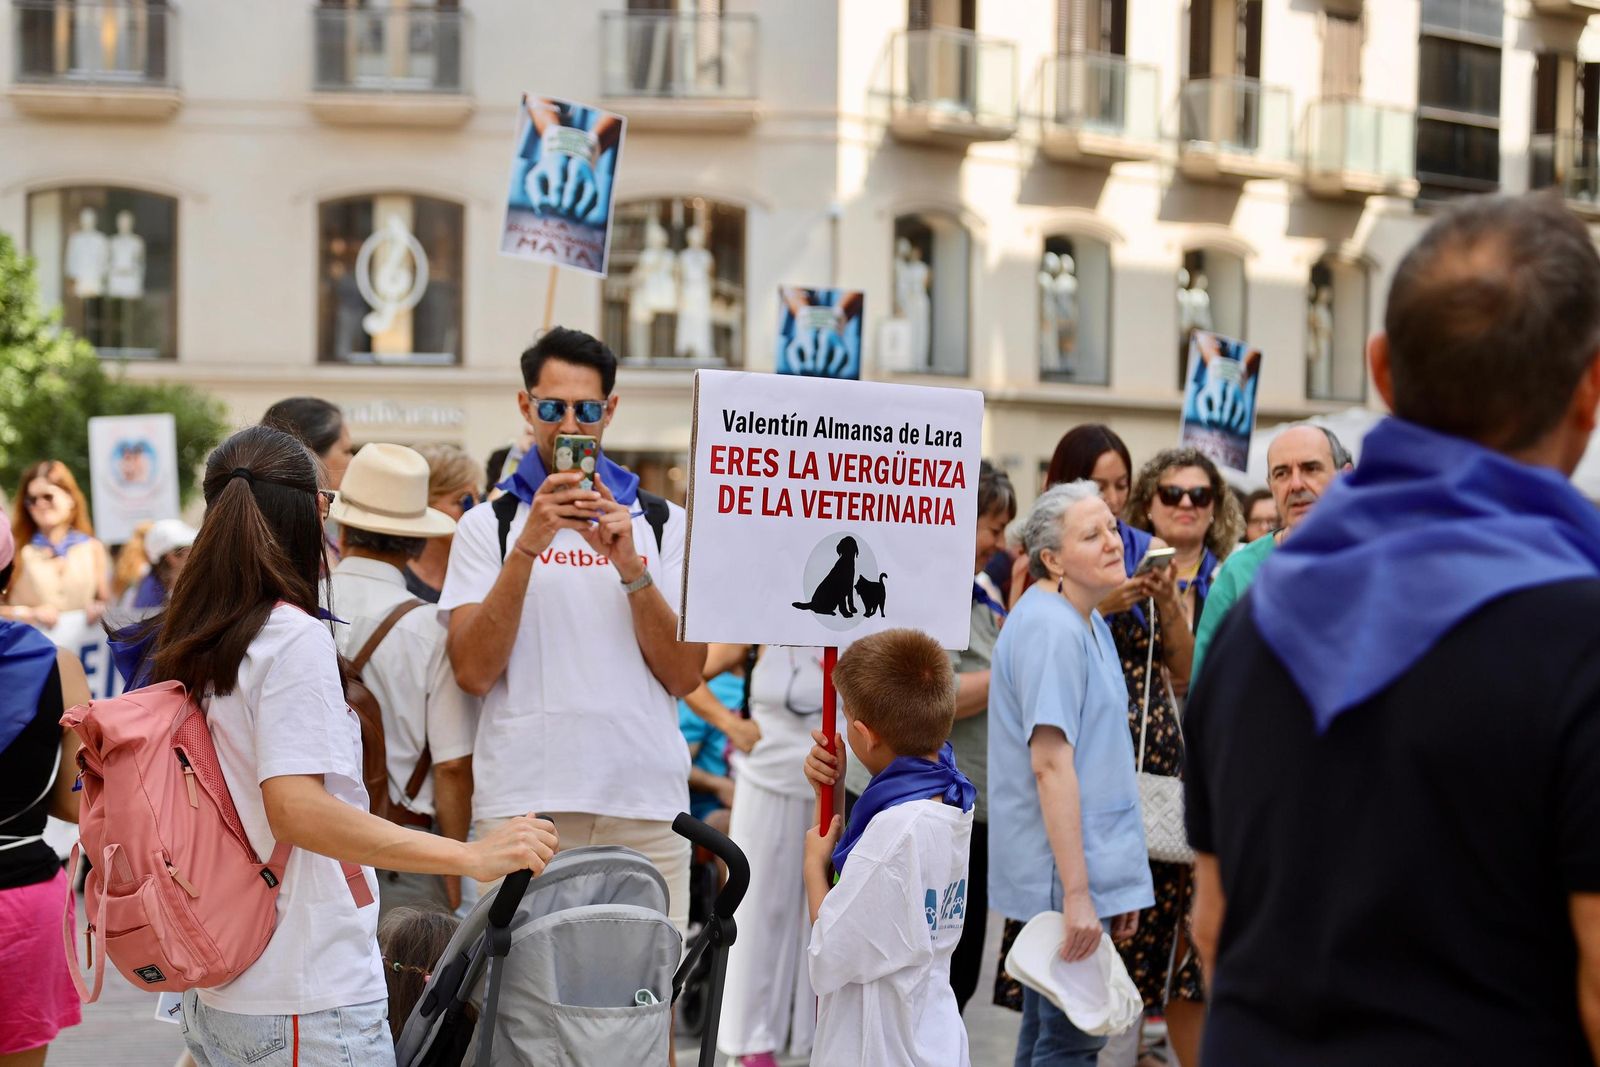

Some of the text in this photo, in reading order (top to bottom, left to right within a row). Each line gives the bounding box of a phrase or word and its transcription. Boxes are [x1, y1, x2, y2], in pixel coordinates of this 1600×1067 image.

[516, 236, 596, 269] MATA
[722, 409, 962, 448] Valentín Almansa de Lara
[709, 445, 966, 489] ERES LA VERGÜENZA
[717, 484, 956, 526] DE LA VETERINARIA
